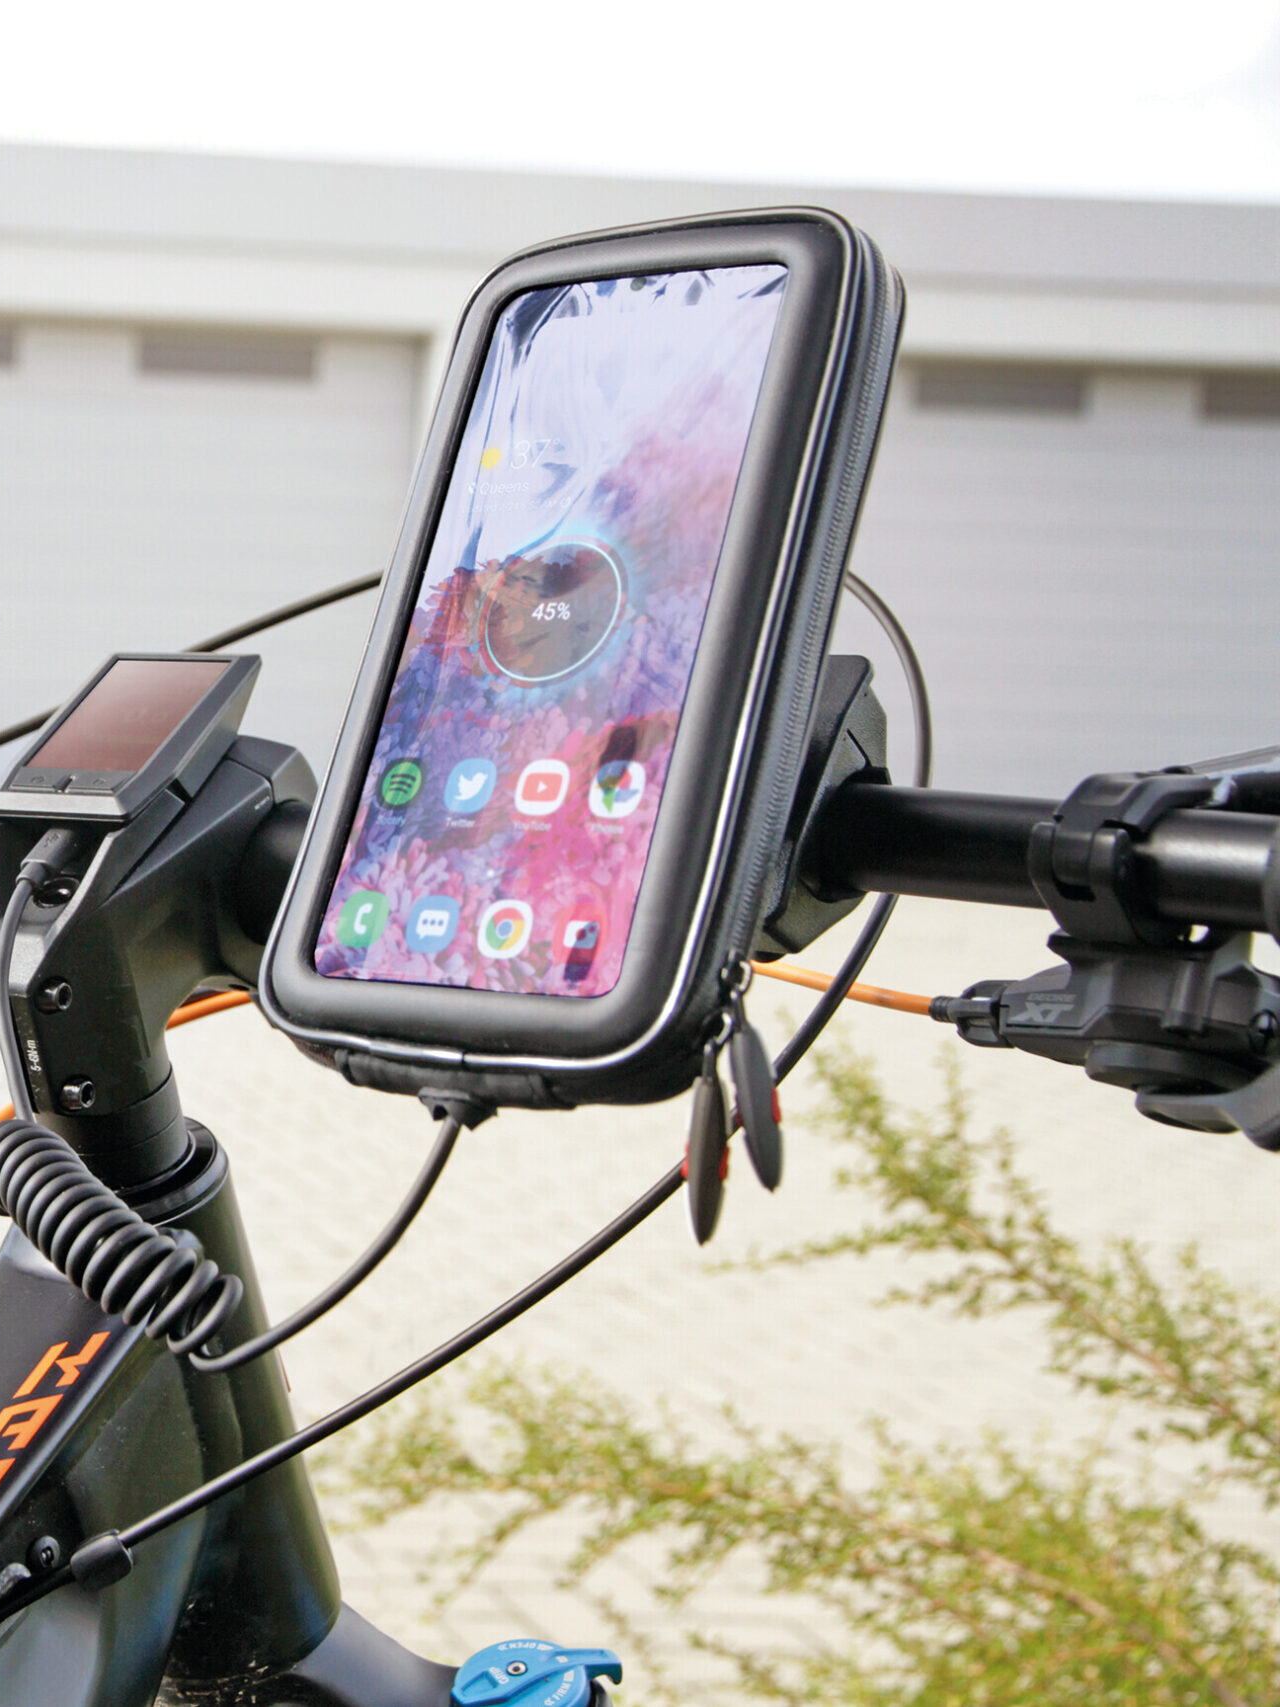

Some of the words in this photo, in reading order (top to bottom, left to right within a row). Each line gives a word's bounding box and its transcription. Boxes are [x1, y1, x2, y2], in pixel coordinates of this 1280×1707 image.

[480, 481, 529, 496] Queens
[531, 601, 571, 621] 45%
[1012, 1001, 1075, 1023] XT
